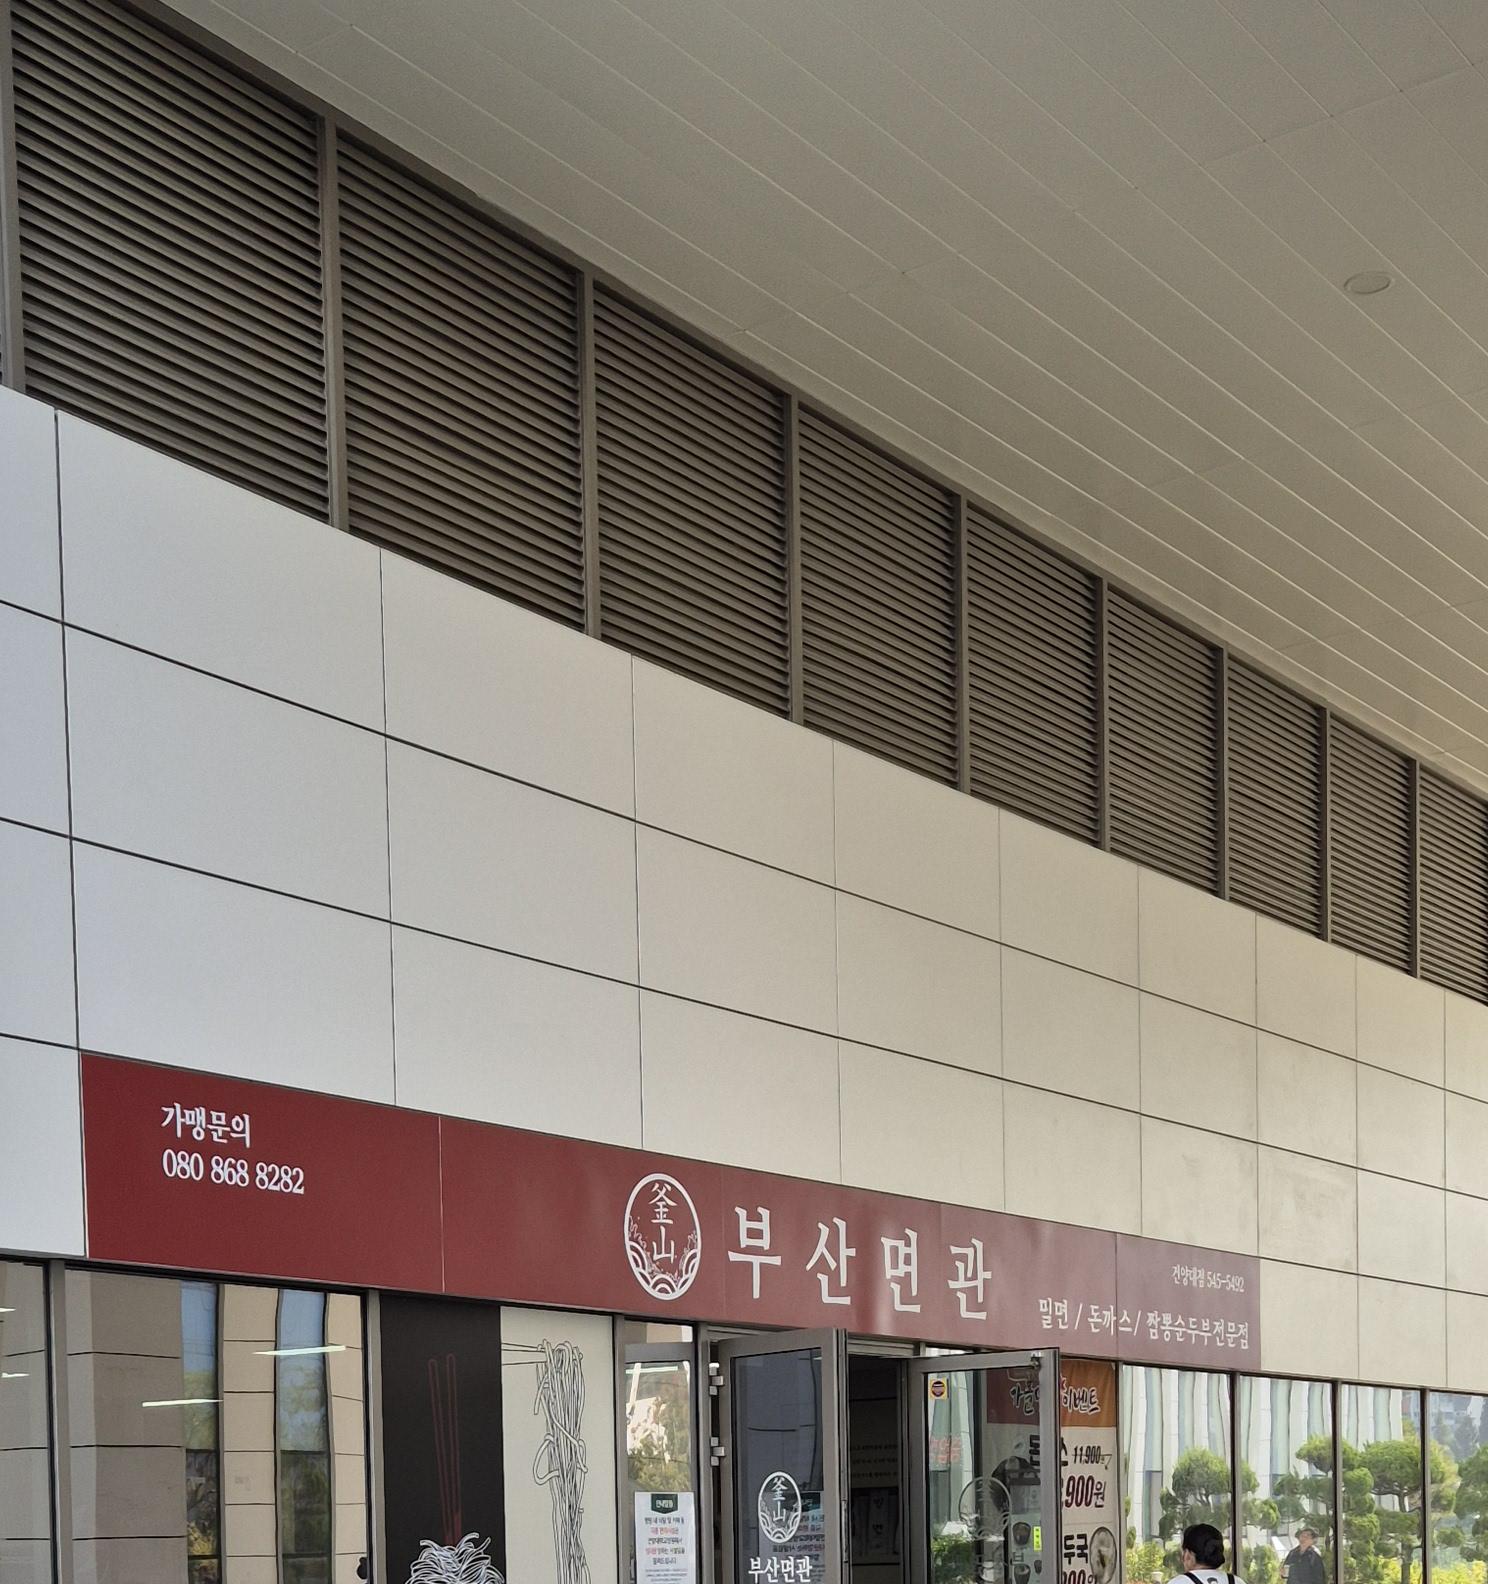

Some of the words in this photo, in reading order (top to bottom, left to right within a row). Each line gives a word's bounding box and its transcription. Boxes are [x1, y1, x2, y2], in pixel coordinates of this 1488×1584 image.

[161, 1102, 250, 1149] 가맹문의
[162, 1148, 204, 1181] 080
[210, 1155, 249, 1187] 868
[255, 1162, 305, 1195] 8282
[648, 1182, 677, 1264] 釜山
[728, 1206, 992, 1320] 부산면관
[1171, 1263, 1205, 1288] 건양대점
[1206, 1271, 1245, 1293] 545-5492
[1038, 1297, 1069, 1330] 밀면
[748, 1555, 813, 1584] 부산면관
